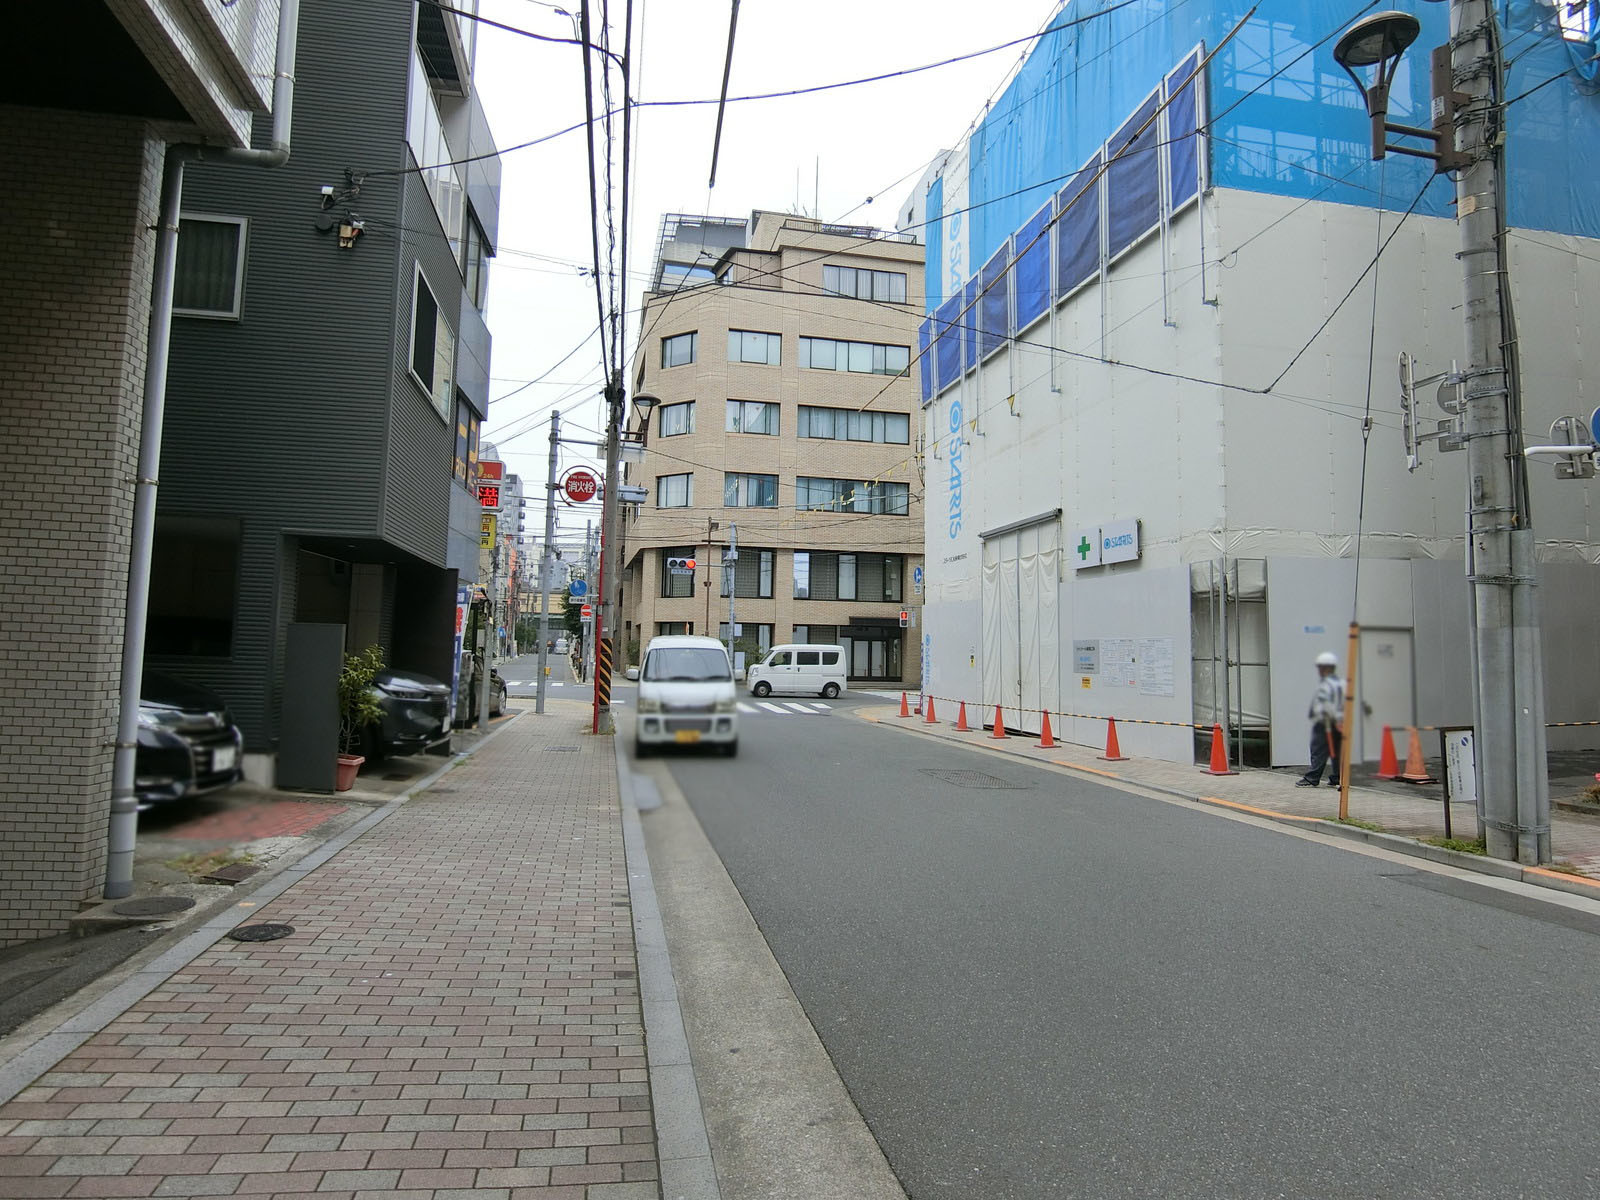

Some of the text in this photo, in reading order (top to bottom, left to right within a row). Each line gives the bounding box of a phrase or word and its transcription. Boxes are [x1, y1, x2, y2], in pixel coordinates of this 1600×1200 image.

[568, 480, 594, 493] 消火栓
[479, 488, 498, 507] 満
